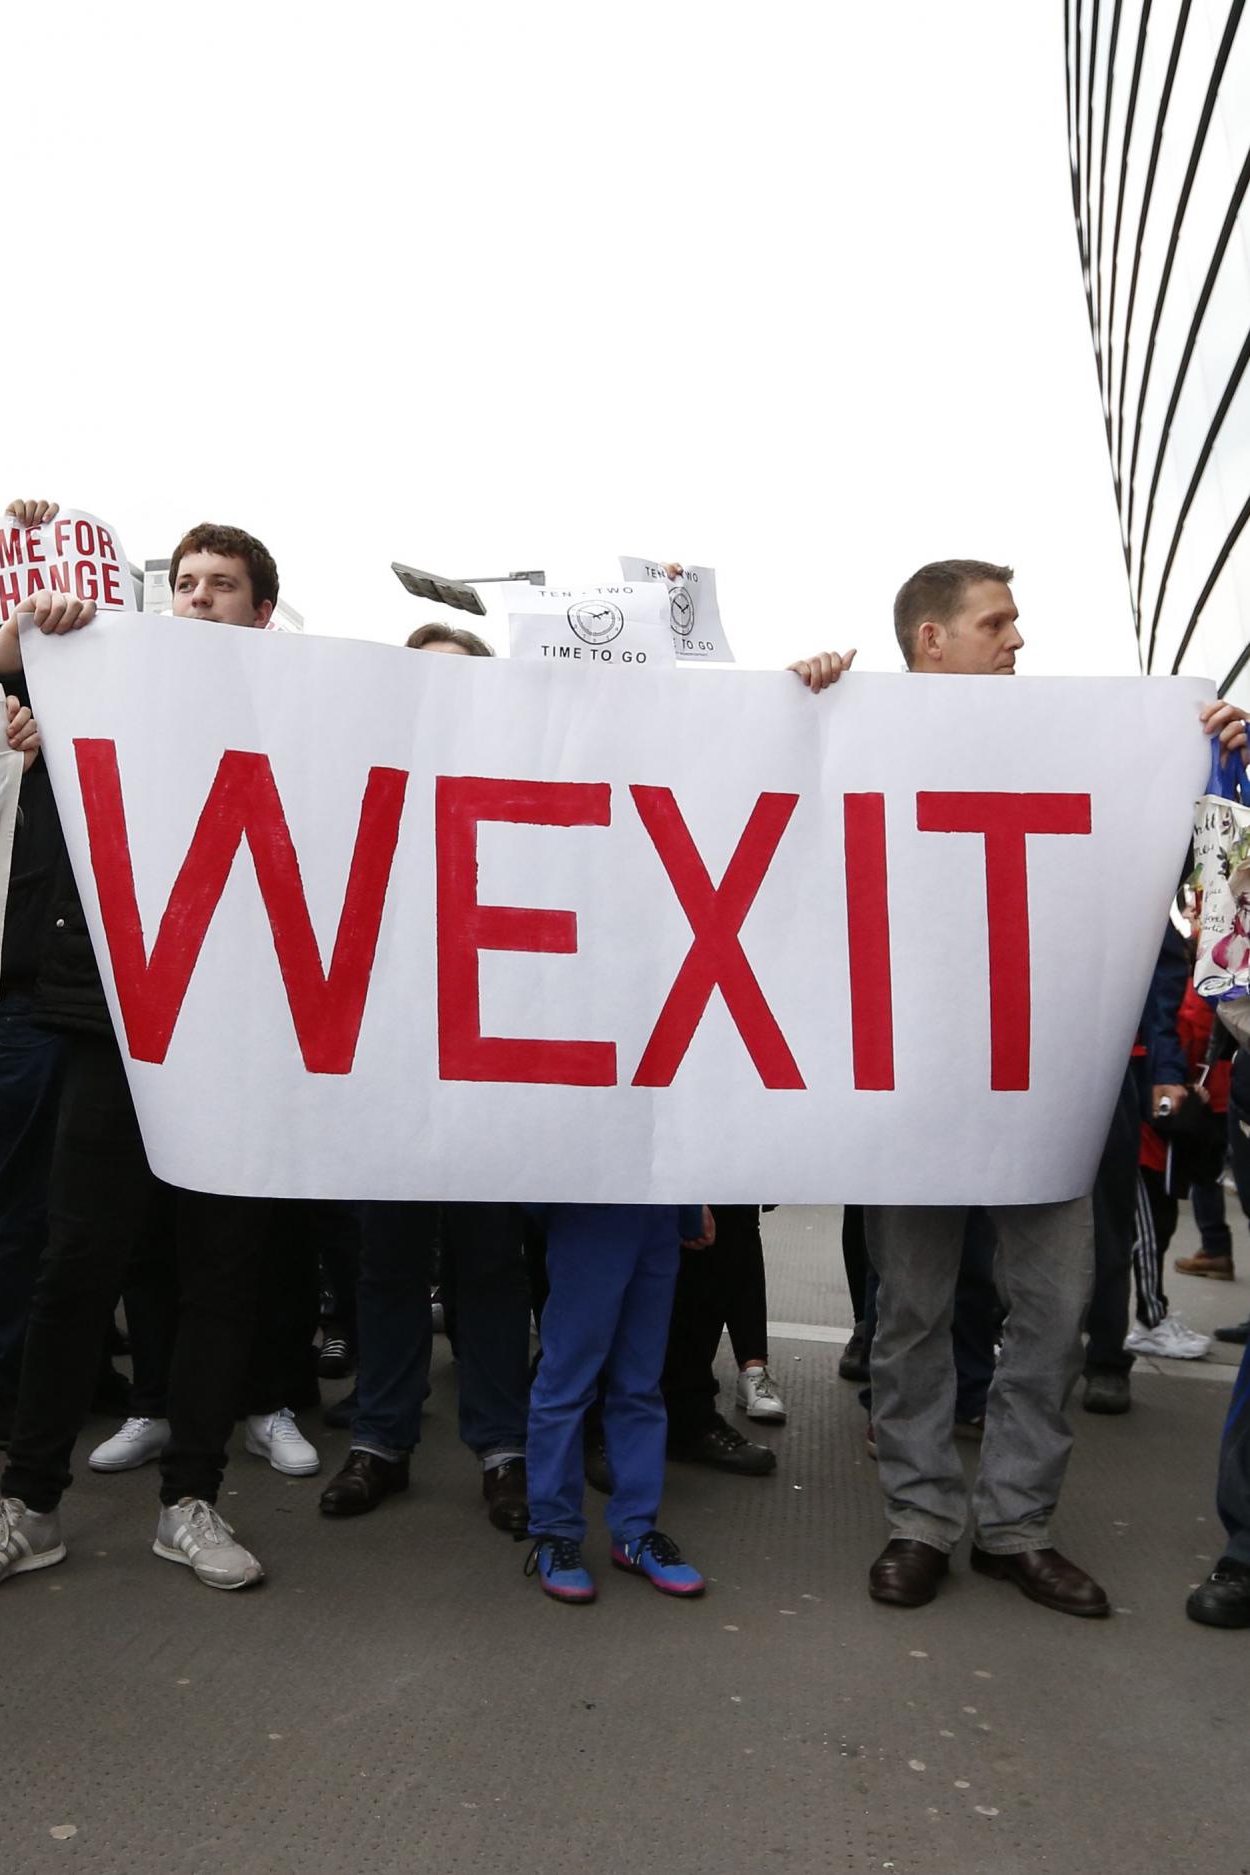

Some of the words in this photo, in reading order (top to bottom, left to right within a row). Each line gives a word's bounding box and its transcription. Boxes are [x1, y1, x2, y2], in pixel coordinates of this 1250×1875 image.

[54, 519, 117, 561] FOR
[645, 566, 666, 579] TEN
[540, 590, 572, 598] TEN
[597, 586, 634, 594] TWO
[681, 638, 694, 649] TO
[698, 640, 714, 651] GO
[541, 645, 582, 659] TIME
[590, 649, 612, 662] TO
[622, 651, 647, 664] GO
[73, 737, 1092, 1091] WEXIT
